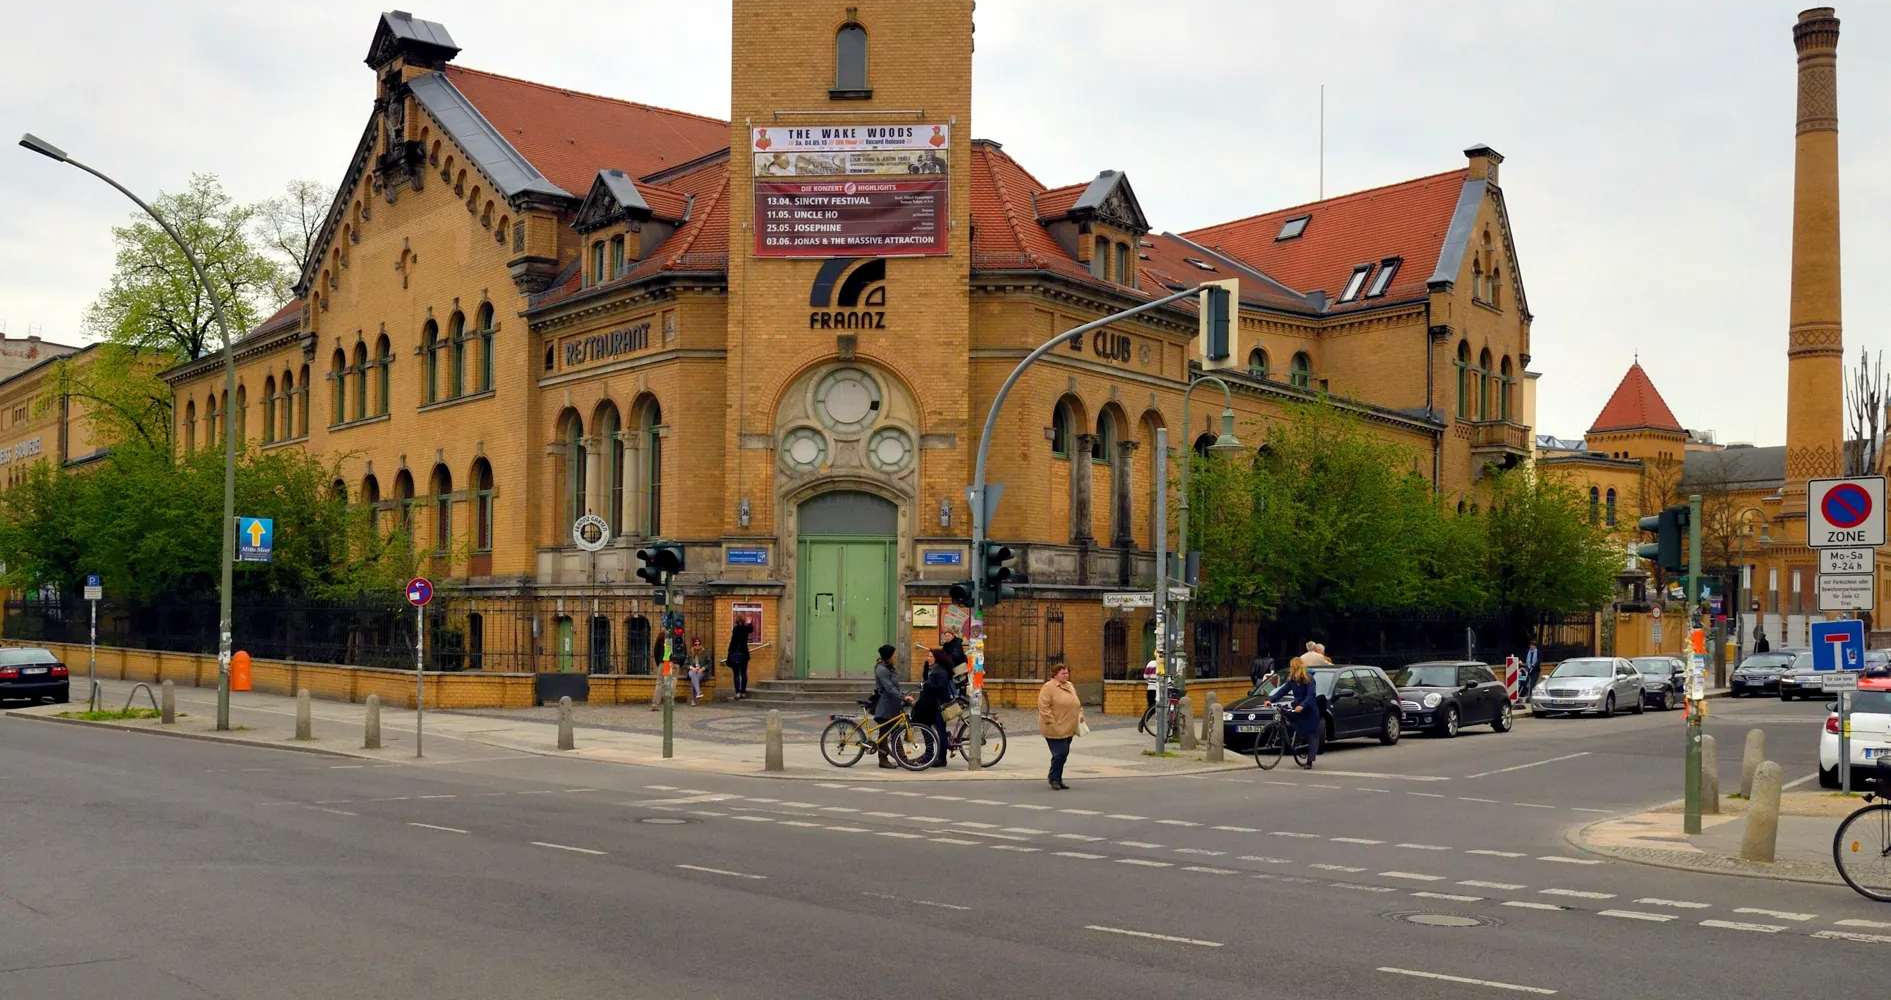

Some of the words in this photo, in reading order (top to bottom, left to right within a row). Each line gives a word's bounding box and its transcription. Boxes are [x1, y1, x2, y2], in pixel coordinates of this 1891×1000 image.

[788, 129, 810, 140] THE
[822, 128, 856, 138] WAKE
[867, 127, 912, 138] WOODS
[767, 198, 792, 206] 13.04.
[794, 197, 828, 205] SINCITY
[831, 197, 871, 205] FESTIVAL
[767, 210, 792, 218] 11.05.
[794, 210, 823, 218] UNCLE
[825, 210, 838, 218] HO
[810, 311, 886, 329] FRANNZ
[566, 322, 650, 366] RESTAURANT
[1093, 330, 1131, 362] CLUB
[1828, 531, 1866, 542] ZONE
[1830, 551, 1863, 560] Mo-Sa
[90, 577, 96, 586] P
